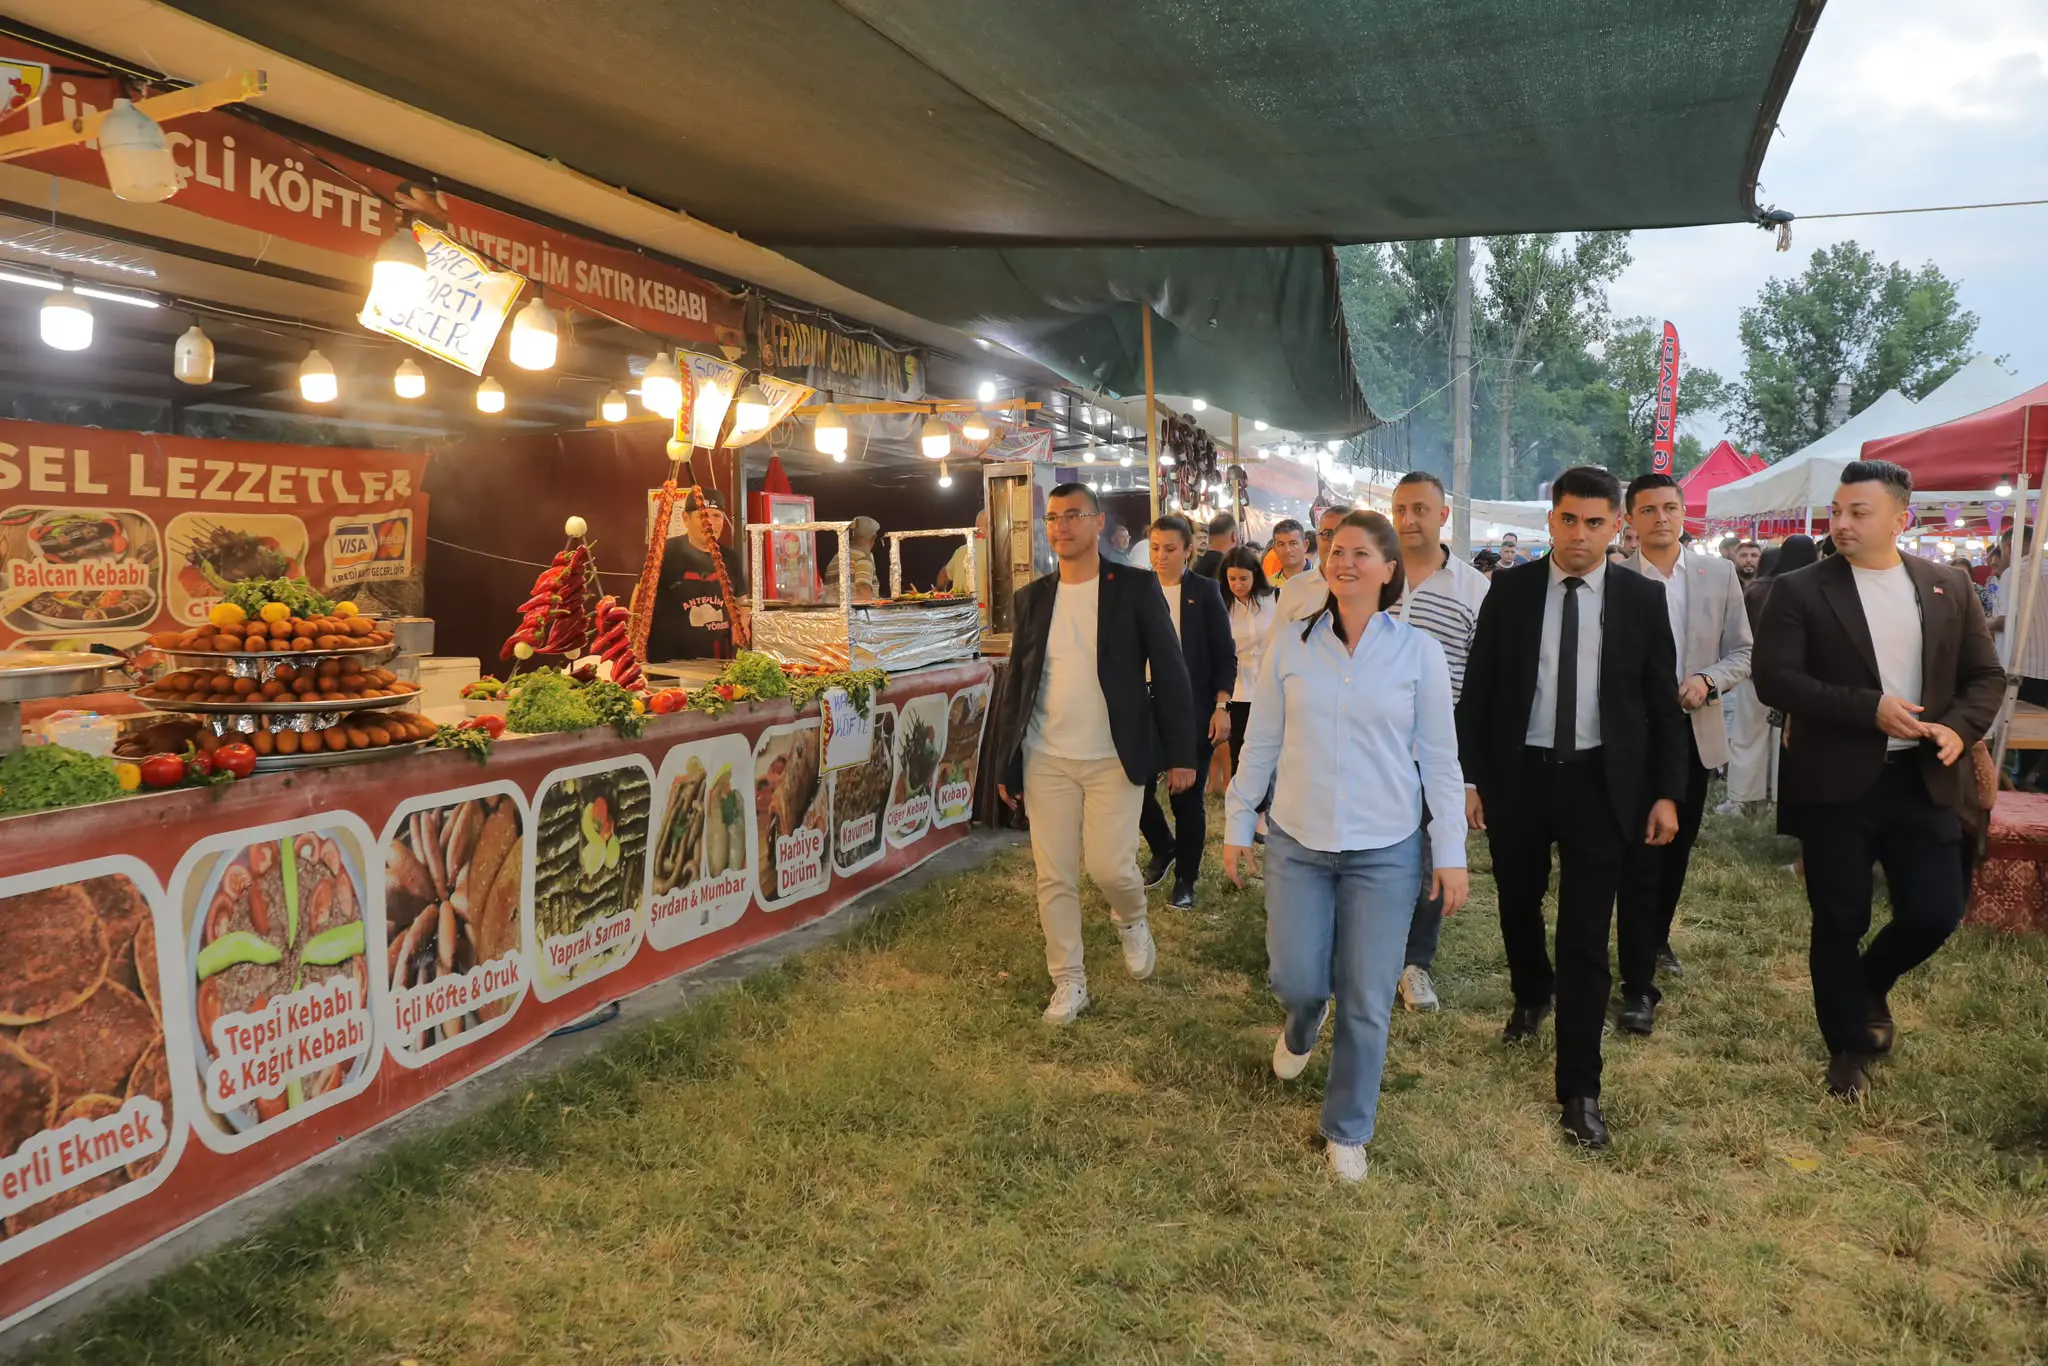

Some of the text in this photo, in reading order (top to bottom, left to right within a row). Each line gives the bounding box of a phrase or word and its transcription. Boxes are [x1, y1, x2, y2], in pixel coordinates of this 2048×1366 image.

[163, 131, 382, 236] ÇLİ KÖFTE
[426, 275, 483, 321] ARTI
[575, 260, 635, 305] SATIR
[638, 280, 708, 323] KEBABI
[129, 453, 412, 504] LEZZETLER
[338, 538, 367, 554] VISA
[13, 561, 145, 588] Balcan Kebabı
[906, 800, 928, 817] Kebap
[941, 787, 968, 804] Kebap
[780, 830, 819, 863] Harbiye
[842, 820, 873, 846] Kavurma
[782, 860, 817, 890] Dürüm
[650, 876, 746, 928] Şırdan & Mumbar
[549, 914, 631, 967] Yaprak Sarma
[395, 960, 519, 1032] İçli Köfte & Oruk
[224, 990, 354, 1061] Tepsi Kebabı
[217, 1021, 365, 1100] & Kağıt Kebabı
[59, 1108, 154, 1174] Ekmek
